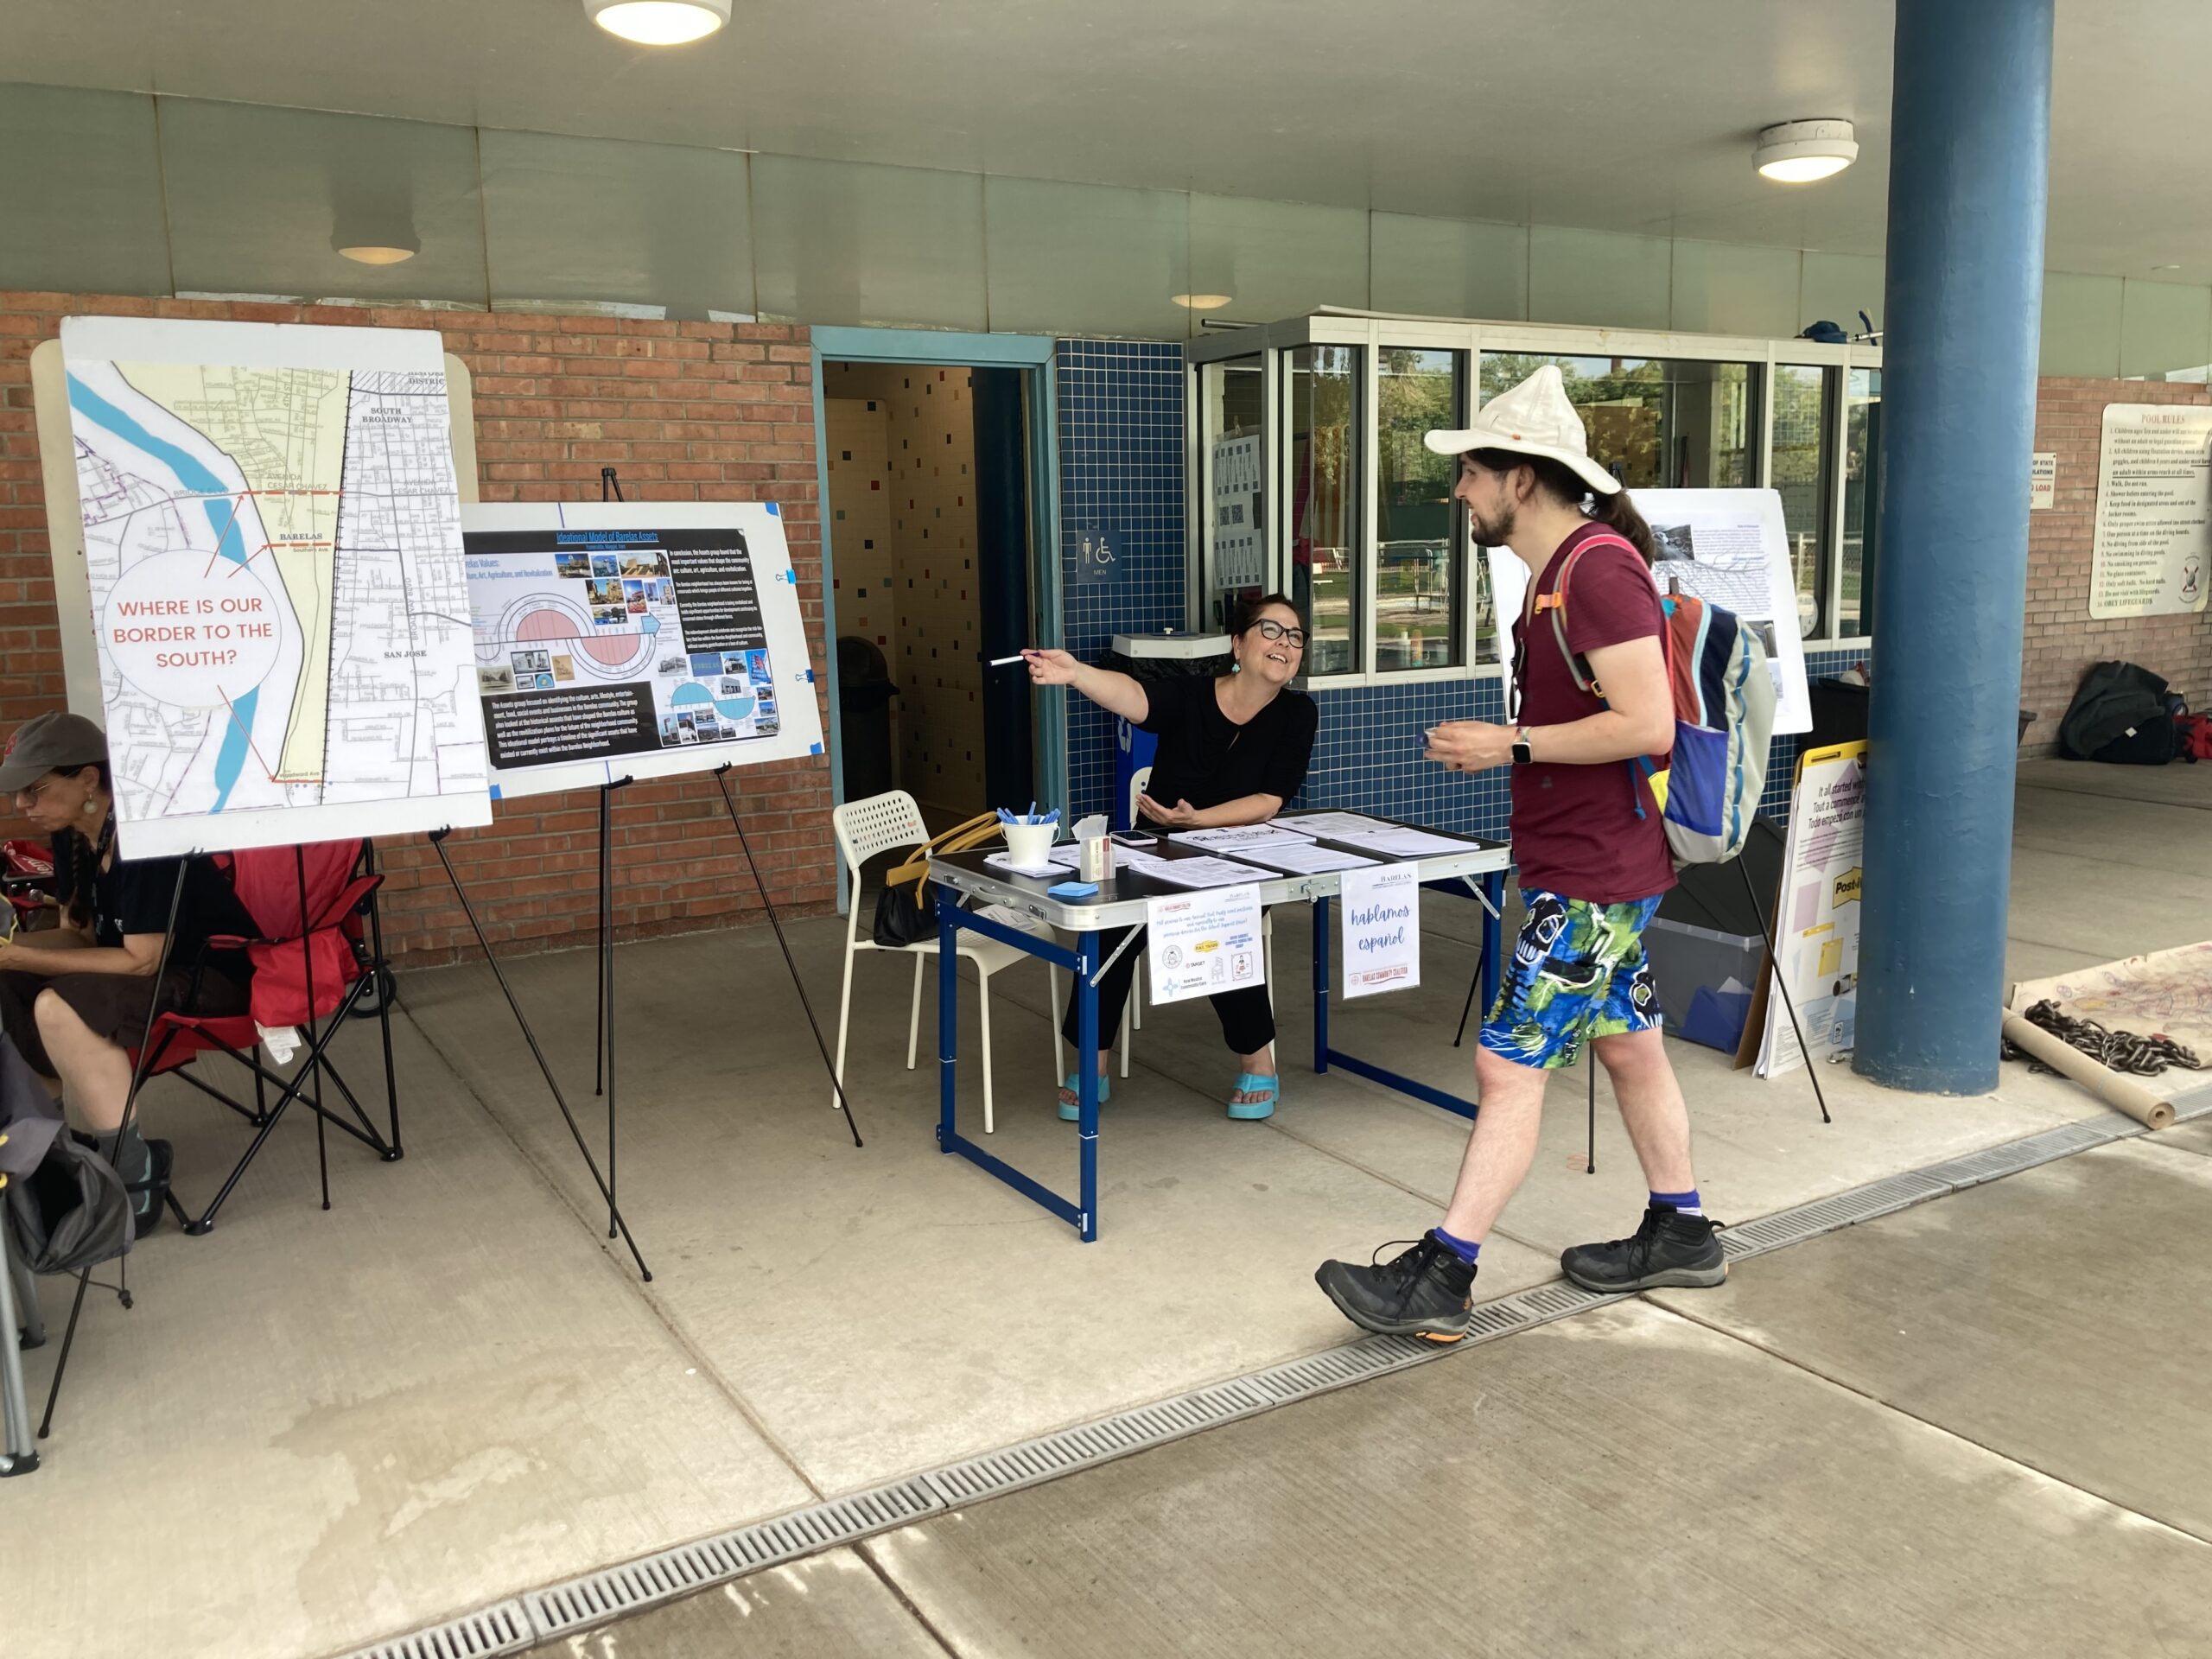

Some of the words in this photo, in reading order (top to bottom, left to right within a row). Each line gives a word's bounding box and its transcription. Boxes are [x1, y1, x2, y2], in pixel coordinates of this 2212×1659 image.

[2142, 415, 2162, 423] POOL
[2162, 415, 2184, 424] RULES
[588, 531, 607, 542] Model
[608, 531, 615, 542] of
[616, 531, 638, 542] Barelas
[639, 531, 658, 541] Assets
[466, 559, 479, 568] relas
[118, 601, 190, 616] WHERE
[196, 600, 213, 613] IS
[221, 598, 263, 613] OUR
[113, 626, 196, 643] BORDER
[203, 625, 230, 639] TO
[237, 623, 273, 638] THE
[156, 650, 237, 668] SOUTH?
[1819, 786, 1823, 798] It
[1832, 779, 1852, 794] started
[1814, 801, 1825, 813] Tout
[1826, 802, 1830, 810] a
[1808, 815, 1821, 830] Todo
[1821, 810, 1843, 827] empezó
[1843, 810, 1853, 821] con
[1854, 809, 1862, 818] un
[1351, 904, 1410, 925] hablamos
[1358, 925, 1404, 953] español
[1376, 969, 1392, 980] COMMUNITY
[1393, 967, 1408, 976] COALITION
